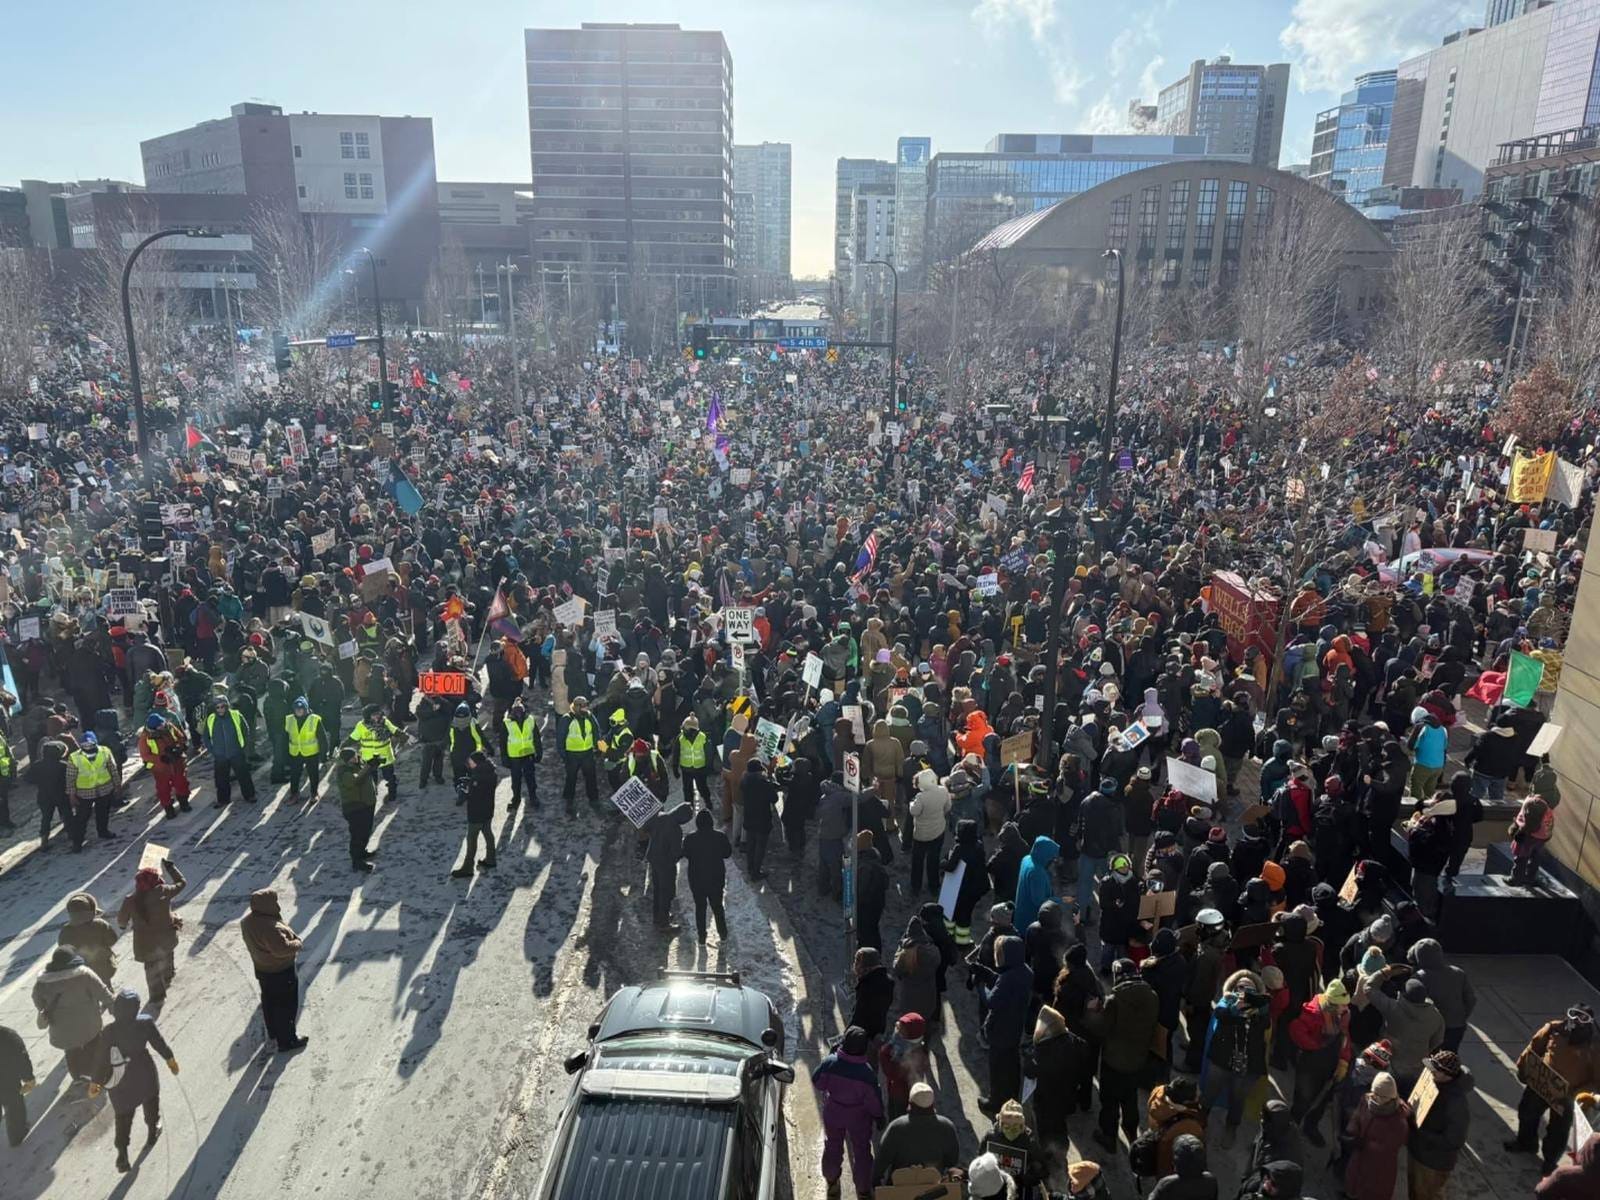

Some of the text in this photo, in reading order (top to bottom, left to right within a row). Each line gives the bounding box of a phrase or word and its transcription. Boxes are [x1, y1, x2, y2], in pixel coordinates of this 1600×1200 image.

[728, 610, 749, 620] ONE
[1215, 585, 1250, 624] WELLS
[728, 620, 750, 629] WAY
[1219, 610, 1246, 643] ARGO
[420, 674, 463, 692] ICE OUT
[618, 783, 647, 811] STRIKE
[628, 794, 658, 823] RACISM
